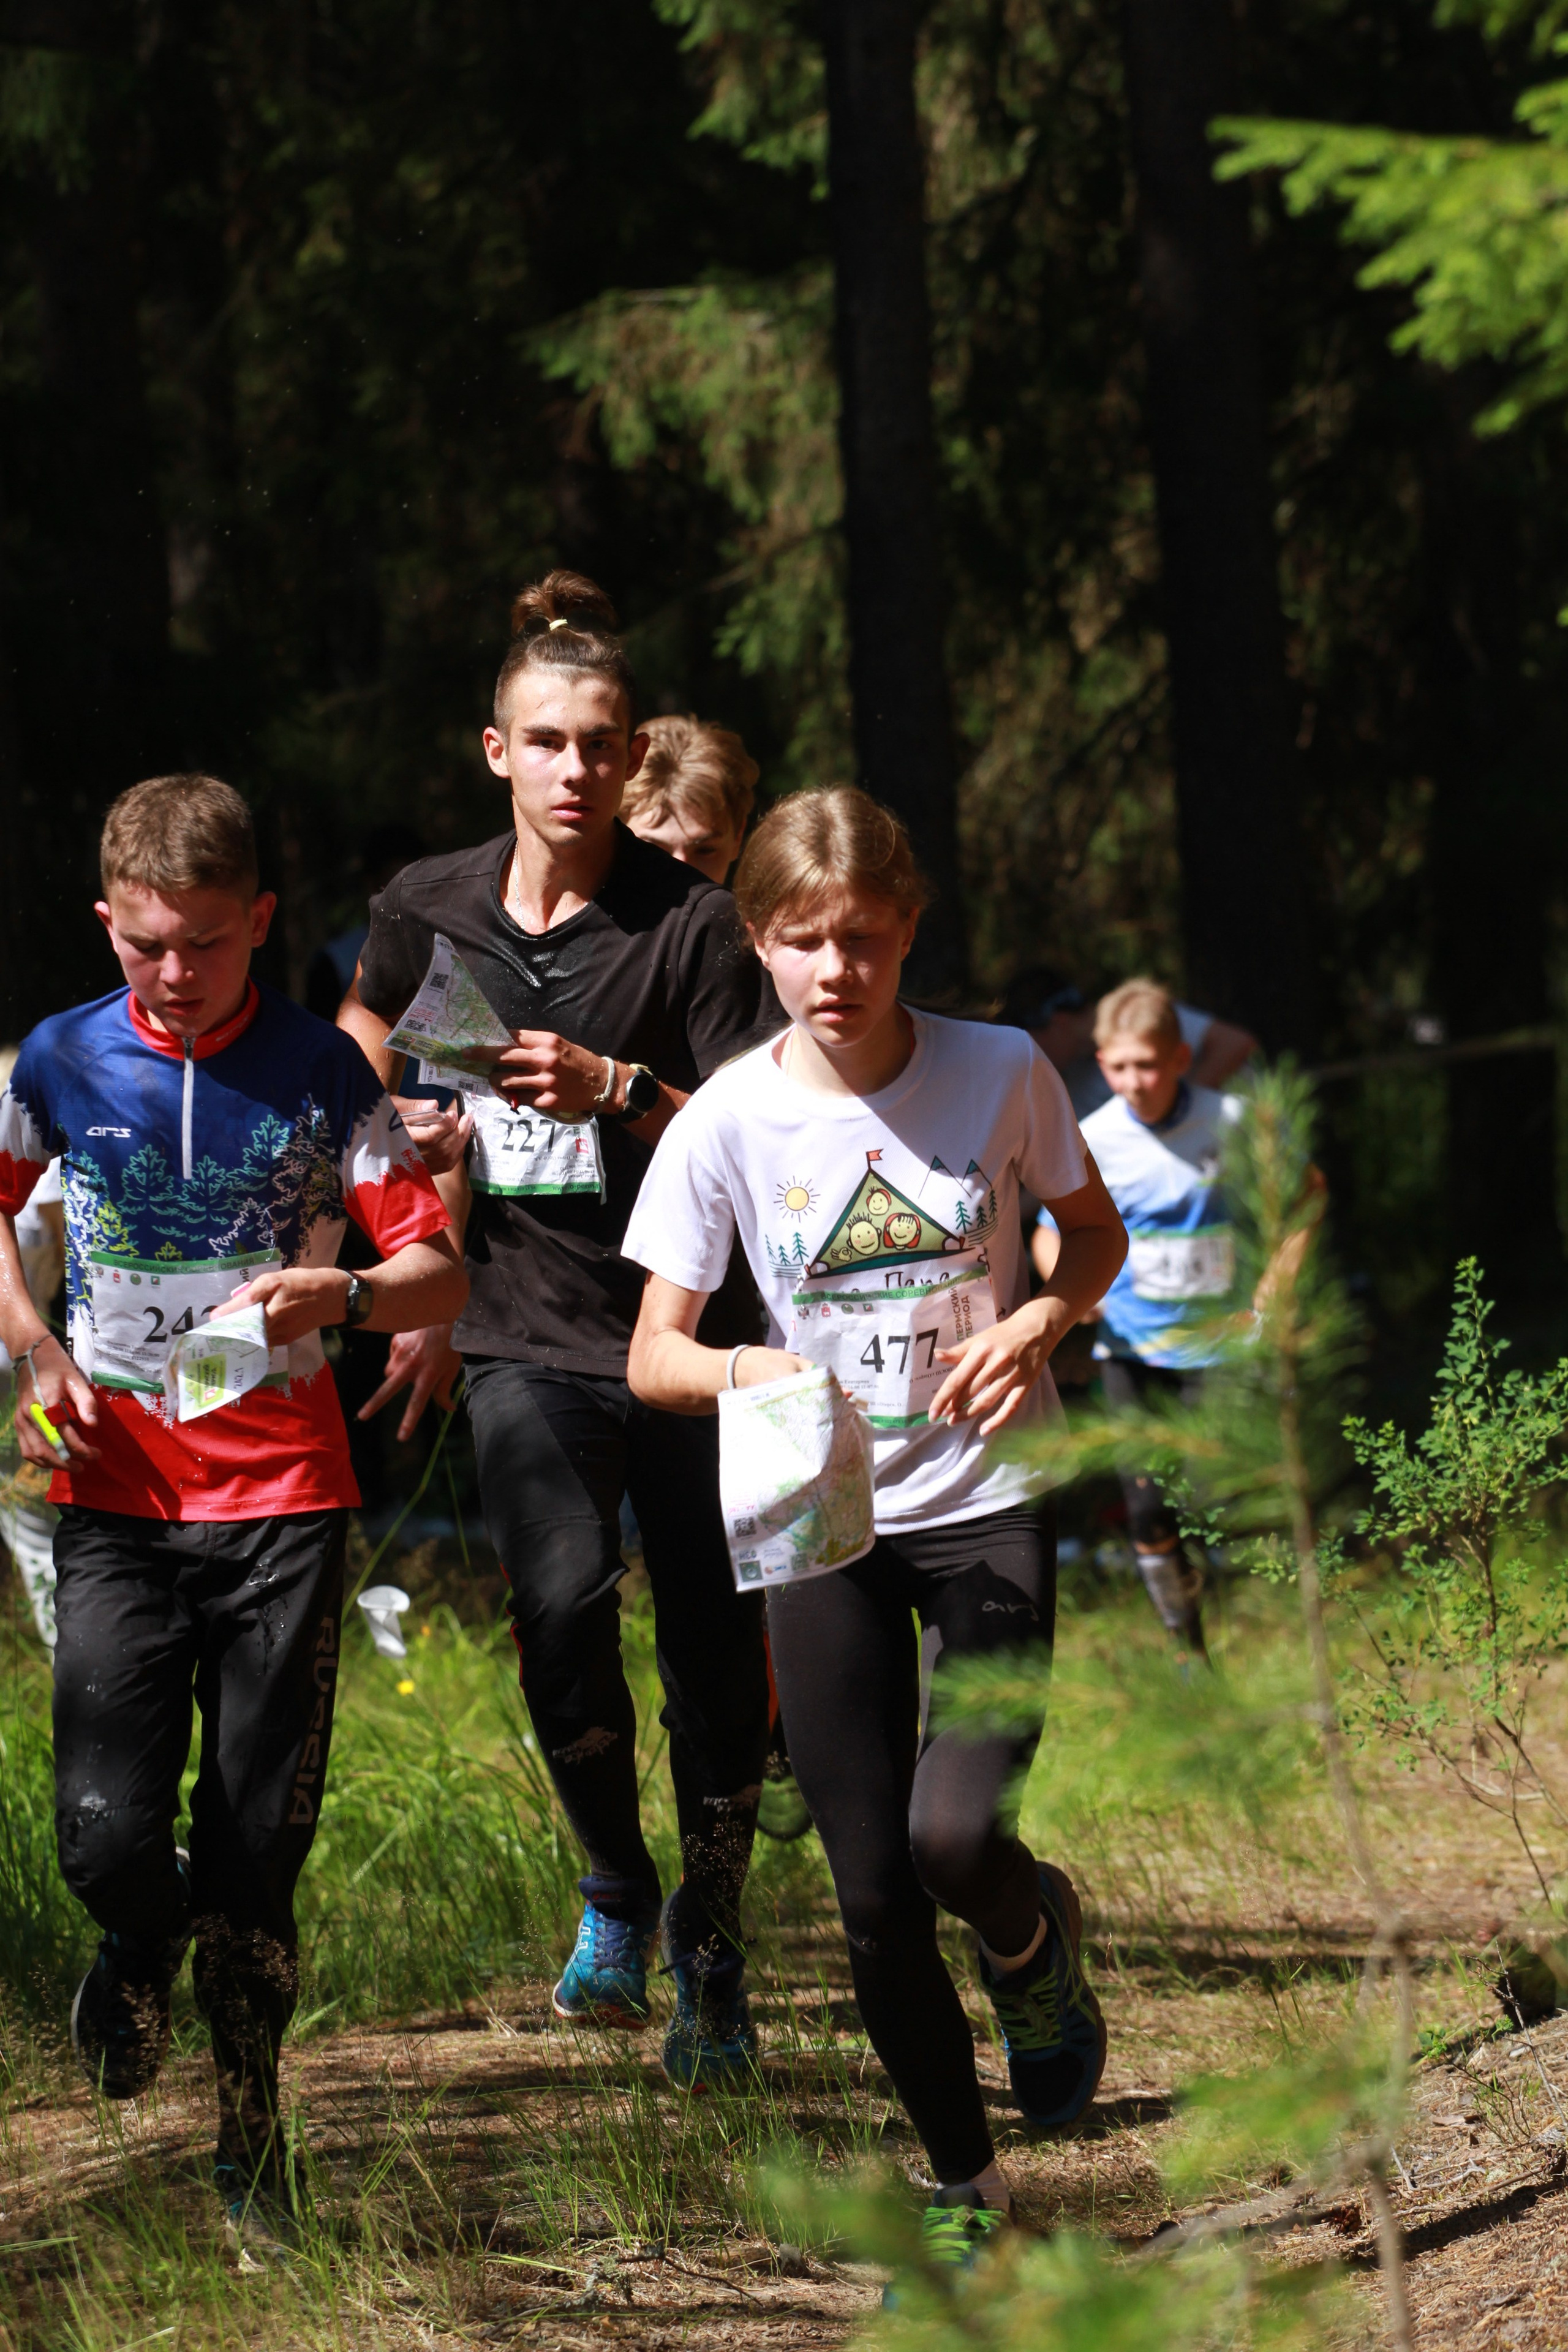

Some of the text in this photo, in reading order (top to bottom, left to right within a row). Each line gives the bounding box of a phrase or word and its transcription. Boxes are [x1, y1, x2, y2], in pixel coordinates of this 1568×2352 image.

[86, 1126, 131, 1137] ars
[497, 1118, 556, 1153] 227
[143, 1305, 219, 1343] 24
[948, 1286, 964, 1341] ПЕРМСКИЙ
[961, 1295, 973, 1338] ПЕРИОД
[860, 1327, 939, 1374] 477
[288, 1617, 337, 1824] RUSSIA
